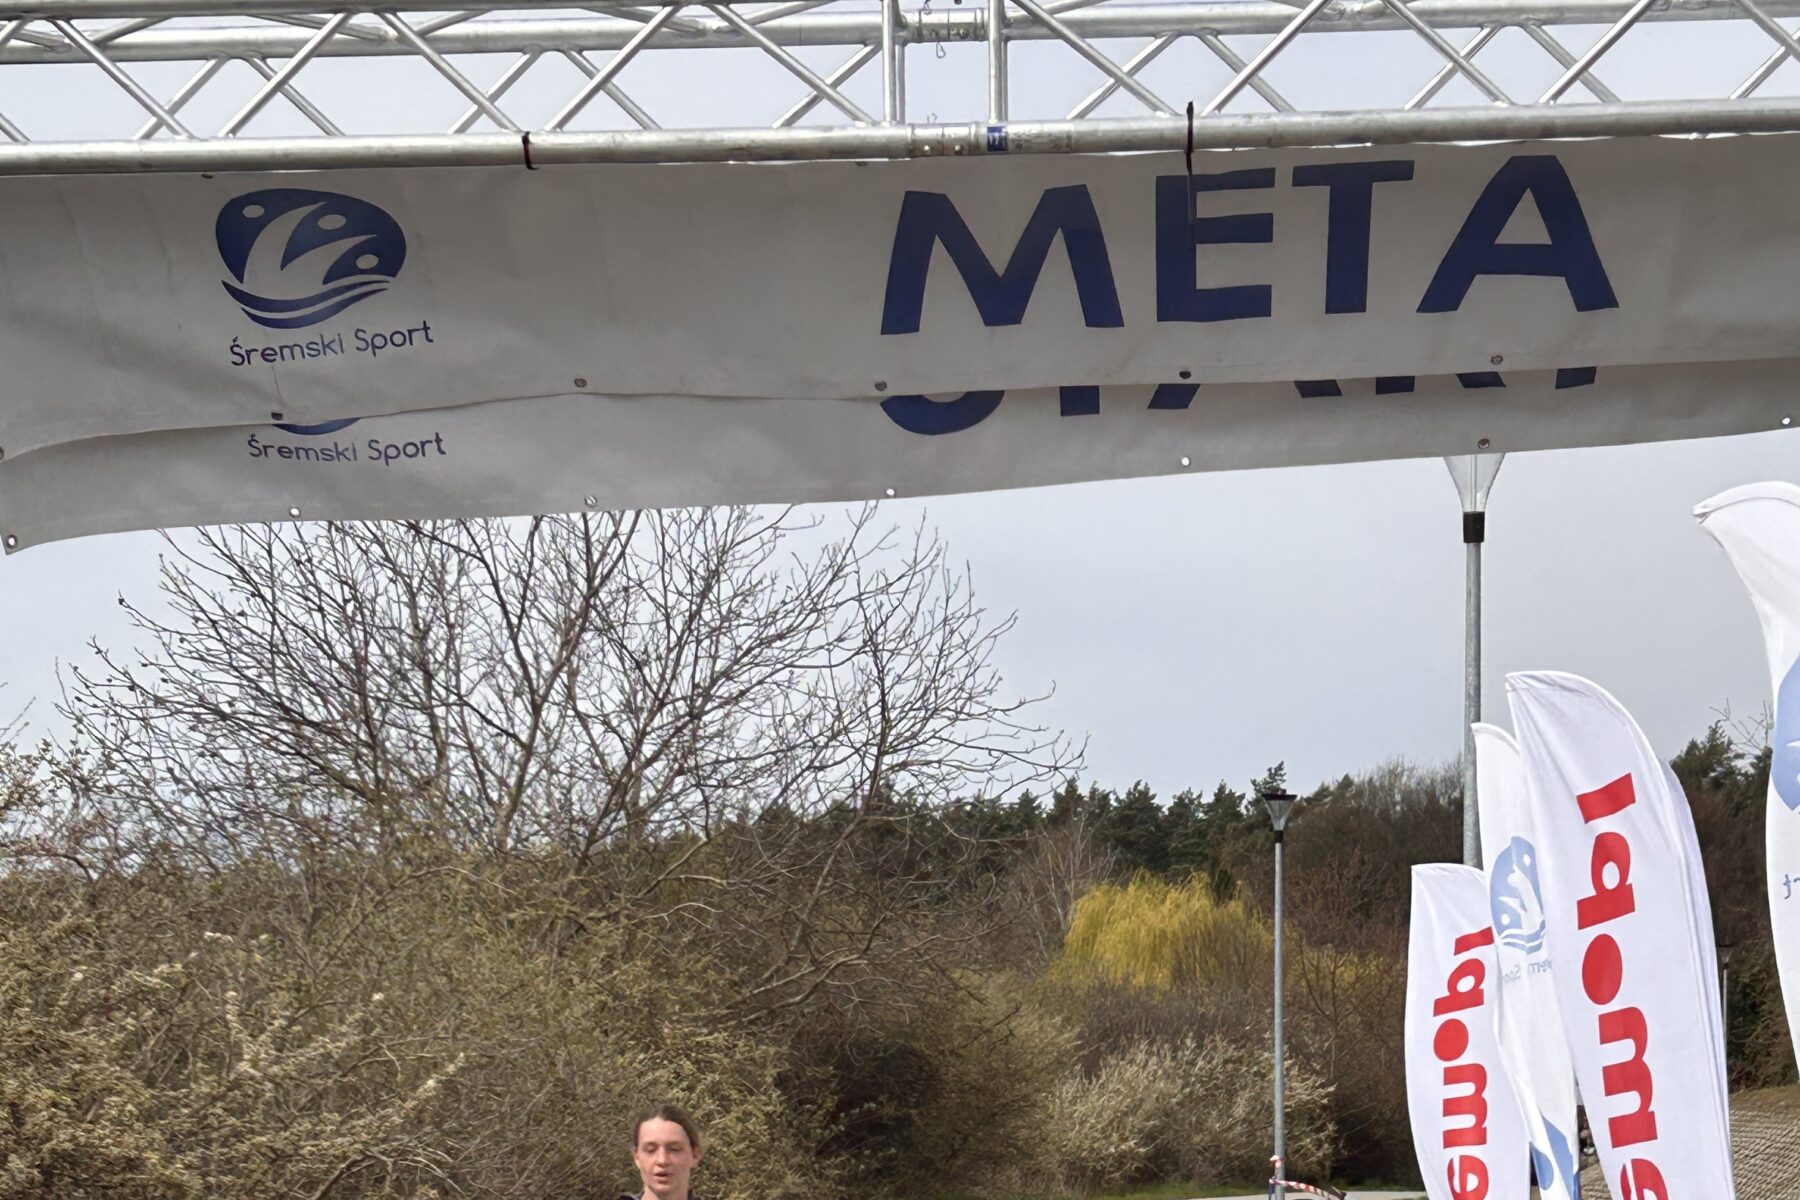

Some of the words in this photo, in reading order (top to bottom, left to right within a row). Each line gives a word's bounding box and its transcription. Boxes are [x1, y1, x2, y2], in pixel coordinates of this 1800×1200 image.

[881, 154, 1620, 336] META
[229, 332, 345, 367] Śremski
[354, 320, 434, 357] Sport
[247, 433, 358, 462] Śremski
[367, 431, 447, 466] Sport
